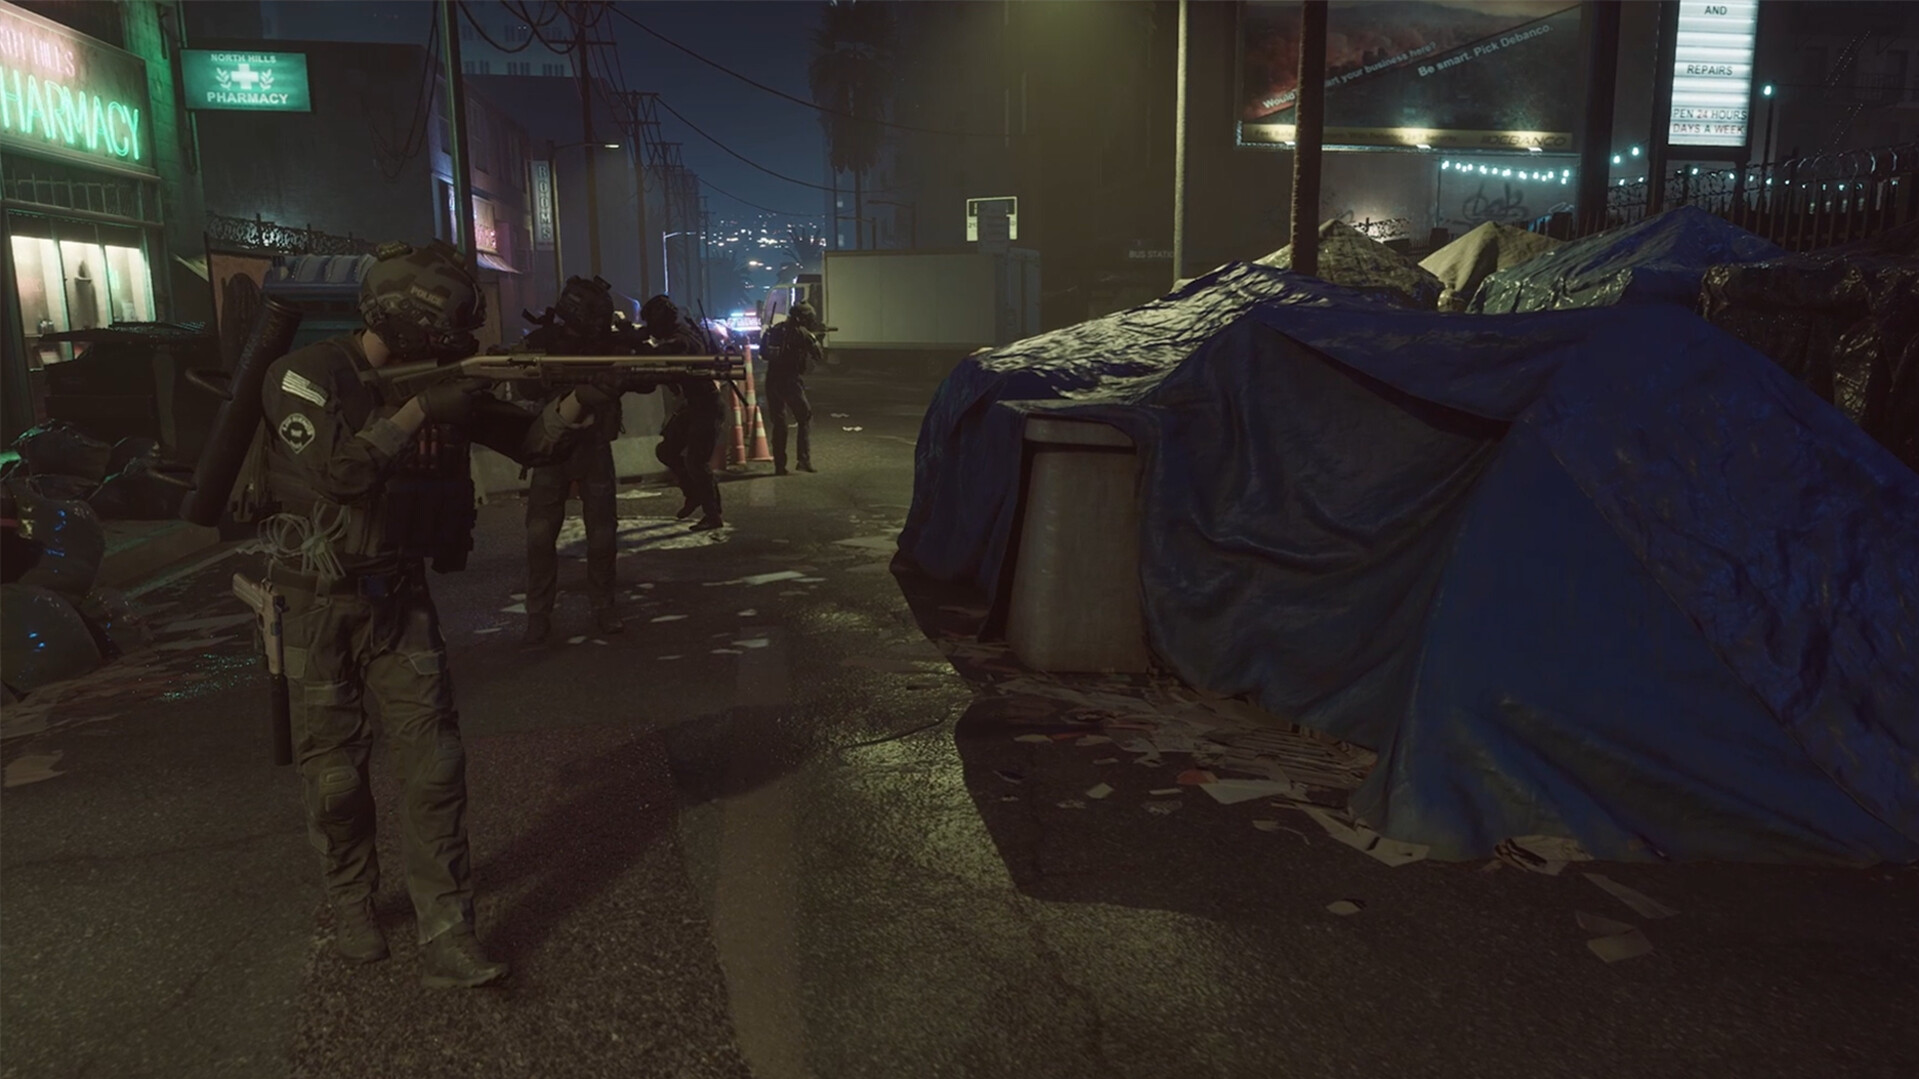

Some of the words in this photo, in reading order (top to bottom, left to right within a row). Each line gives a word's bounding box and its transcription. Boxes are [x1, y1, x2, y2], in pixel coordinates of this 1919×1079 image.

[1704, 5, 1727, 15] AND
[1417, 64, 1436, 77] Be
[1435, 52, 1473, 71] smart.
[1473, 41, 1500, 58] Pick
[1499, 24, 1554, 48] Debanco.
[210, 53, 245, 63] NORTH
[248, 55, 277, 64] HILLS
[1262, 91, 1296, 109] Would
[1341, 68, 1363, 84] your
[1363, 53, 1408, 74] business
[1409, 41, 1437, 57] here?
[1686, 64, 1733, 76] REPAIRS
[206, 91, 289, 105] PHARMACY
[0, 65, 139, 160] HARMACY
[1697, 109, 1708, 119] 24
[1711, 110, 1748, 121] HOURS
[1673, 123, 1700, 134] DAYS
[1704, 124, 1711, 133] A
[1714, 125, 1745, 135] WEEK
[538, 165, 551, 239] ROOMS
[1129, 250, 1146, 258] BUS
